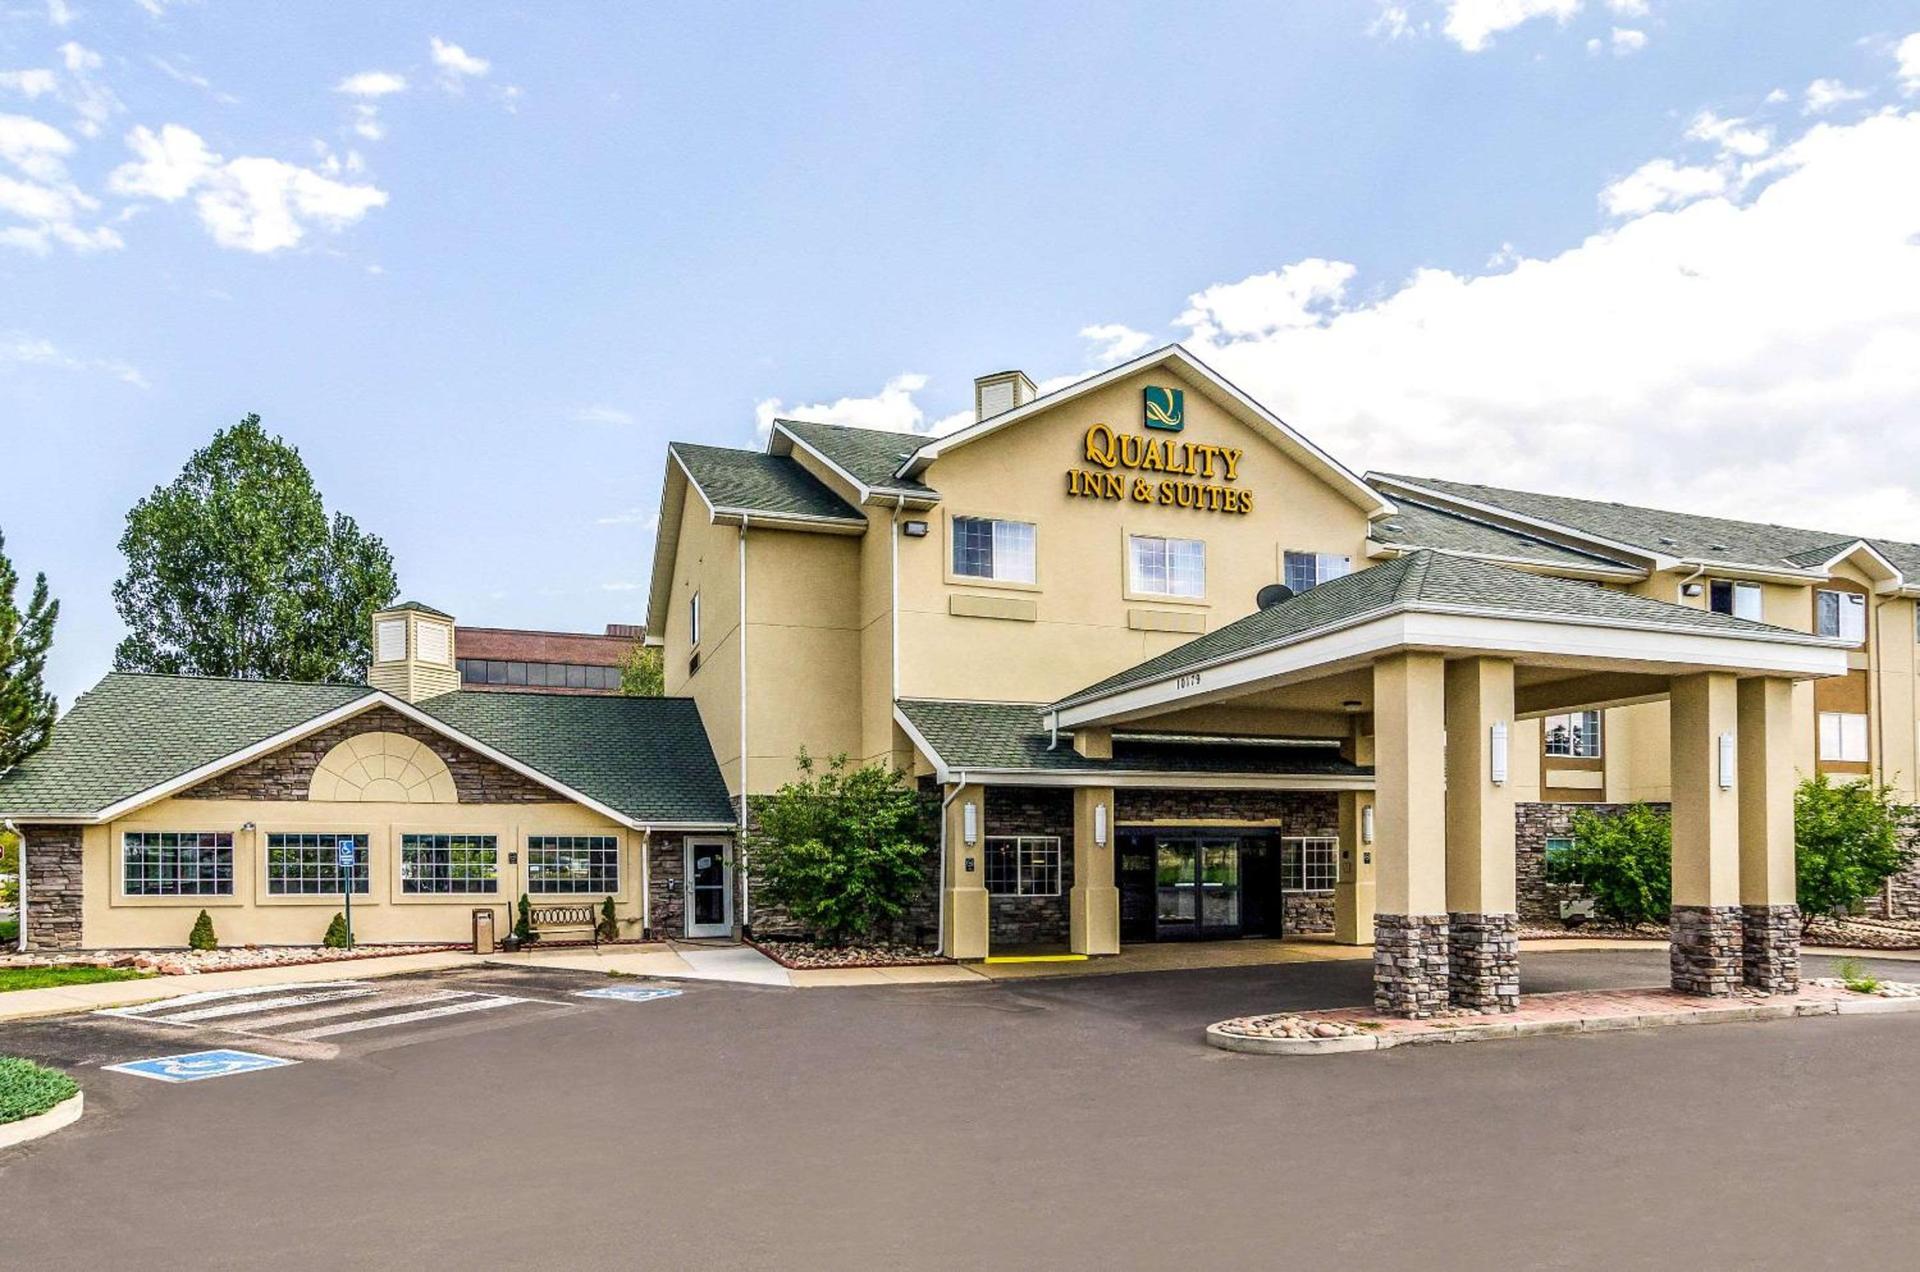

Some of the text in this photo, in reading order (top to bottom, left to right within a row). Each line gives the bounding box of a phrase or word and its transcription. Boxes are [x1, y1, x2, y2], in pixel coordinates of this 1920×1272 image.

[1085, 422, 1242, 480] QUALITY
[1068, 468, 1254, 514] INN & SUITES
